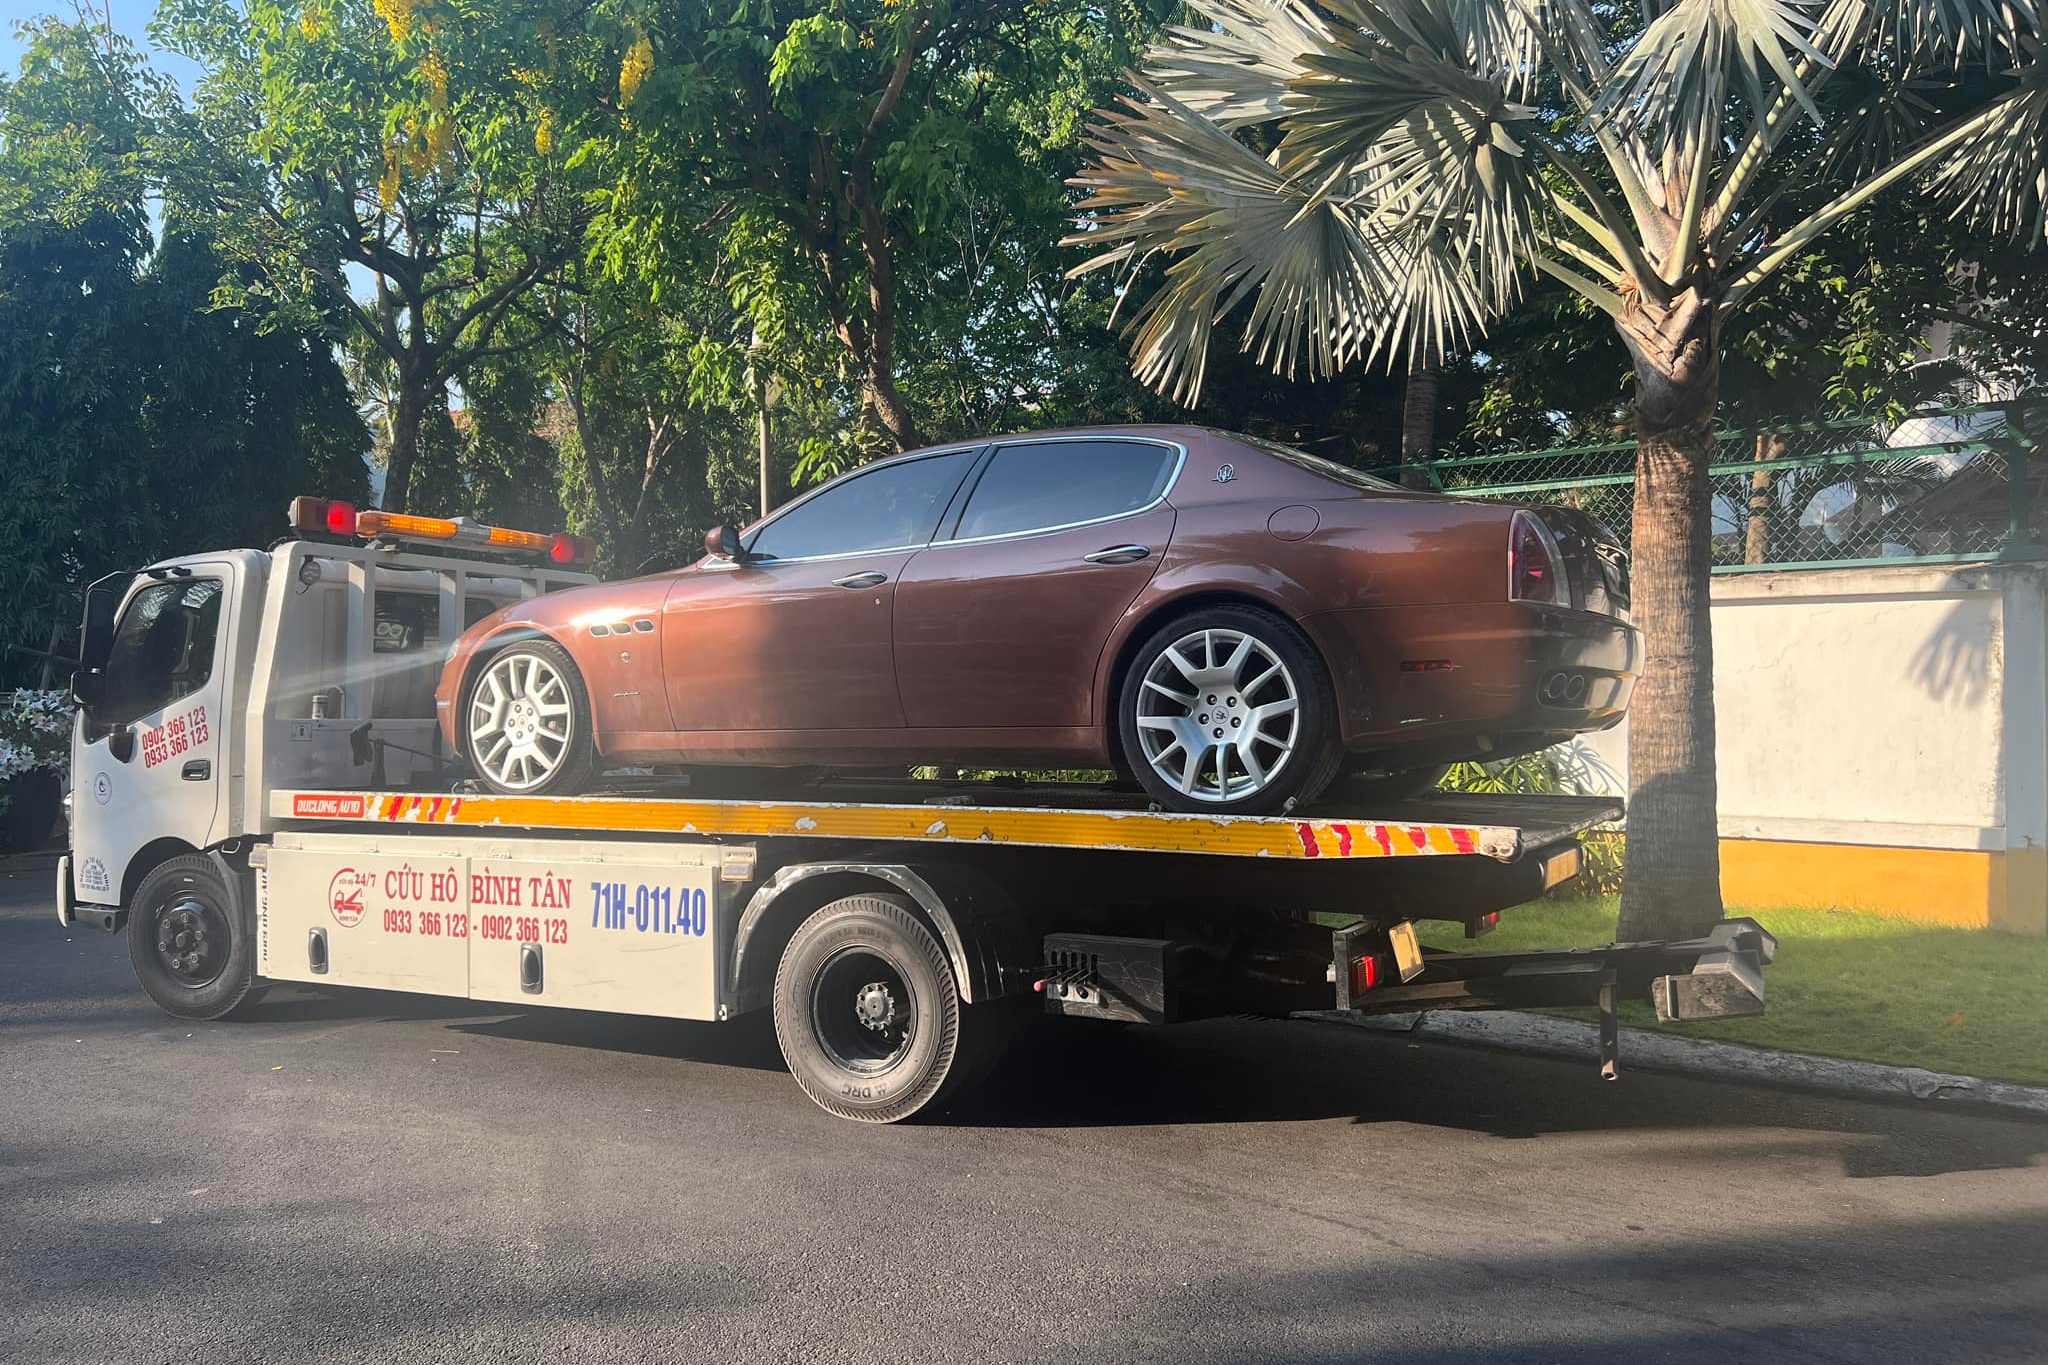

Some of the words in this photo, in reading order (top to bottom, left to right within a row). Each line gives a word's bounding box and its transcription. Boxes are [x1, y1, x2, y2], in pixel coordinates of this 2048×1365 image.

[142, 725, 166, 750] 0902
[167, 715, 185, 738] 366
[187, 705, 206, 728] 123
[144, 743, 168, 768] 0933
[169, 734, 188, 756] 366
[190, 724, 208, 746] 123
[385, 862, 424, 900] CỨU
[471, 866, 521, 906] BÌNH
[528, 870, 572, 908] TÂN
[384, 909, 412, 933] 0933
[419, 911, 441, 935] 366
[445, 913, 468, 937] 123
[482, 915, 512, 940] 0902
[516, 916, 539, 942] 366
[544, 918, 568, 944] 123
[591, 882, 706, 937] 71H-011.40
